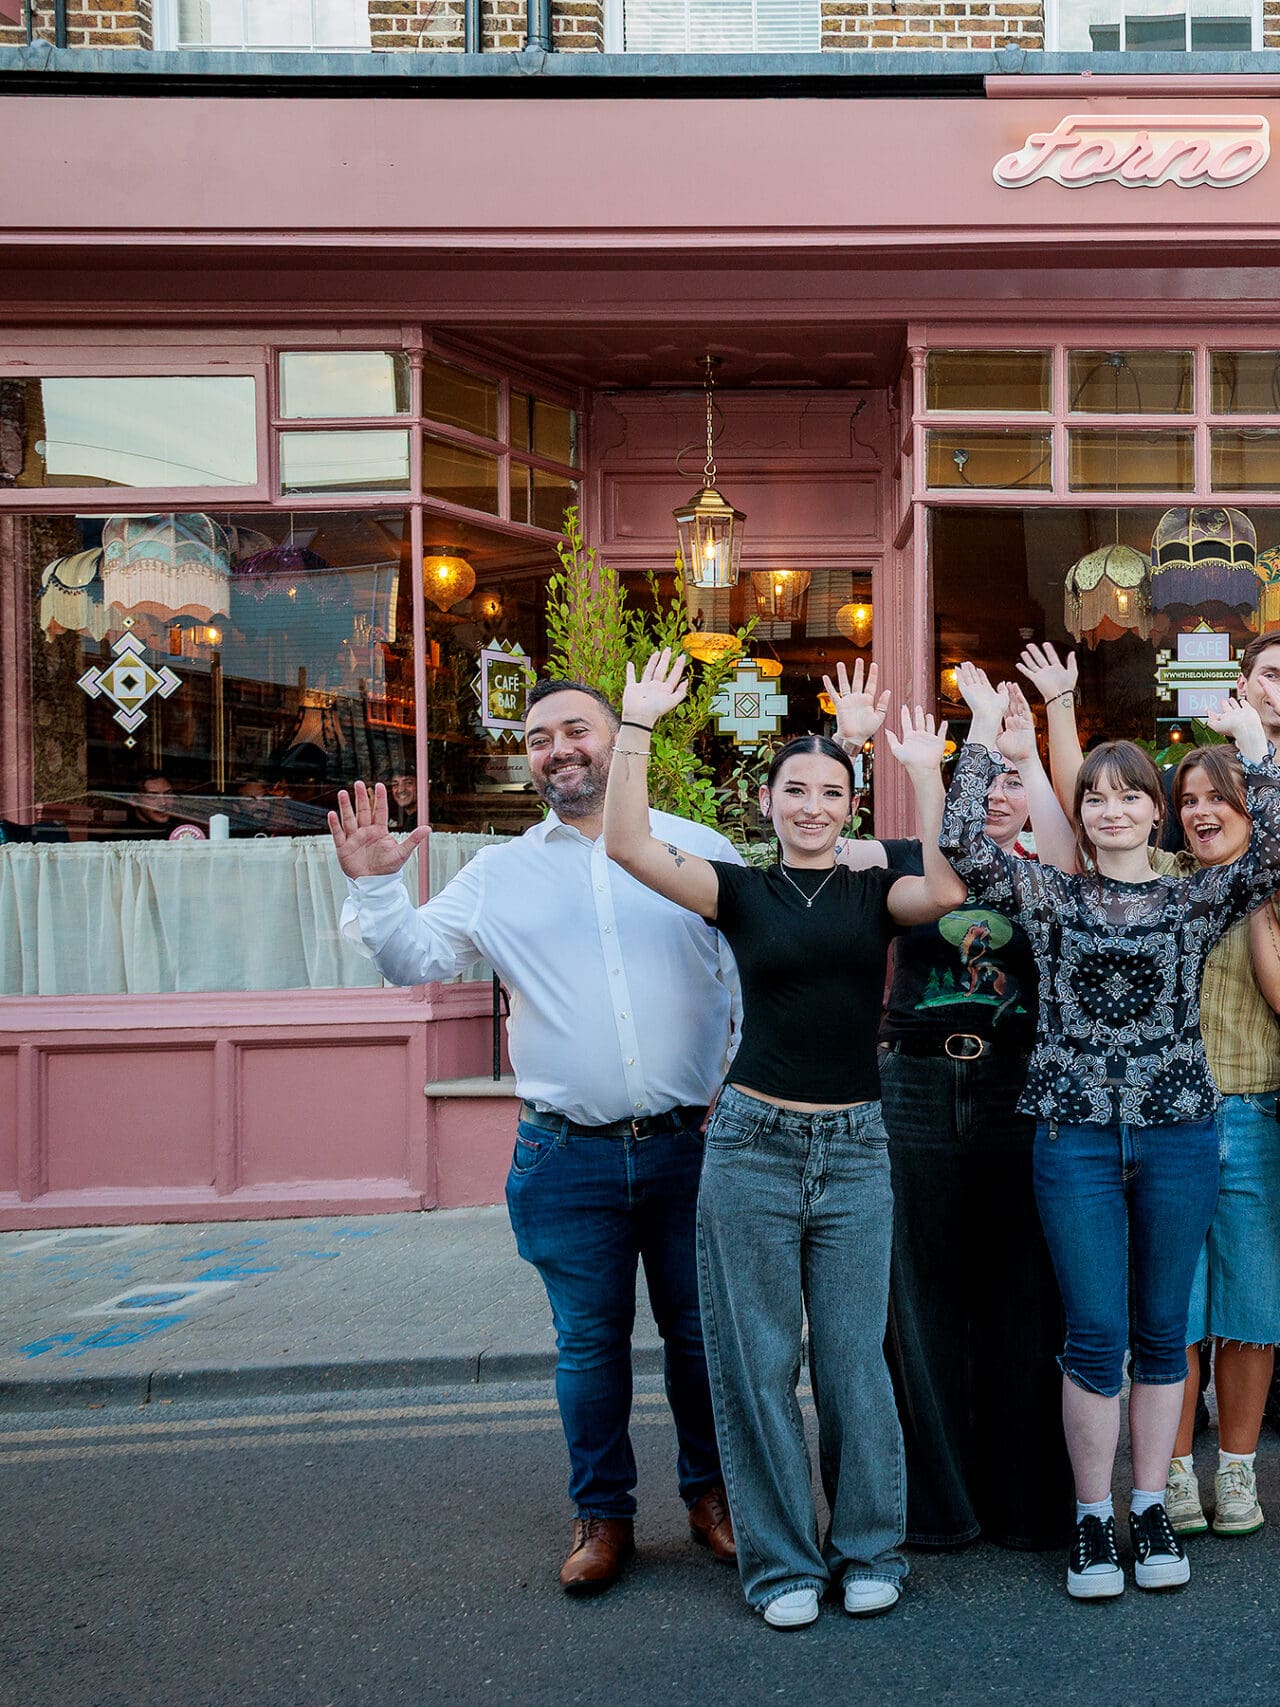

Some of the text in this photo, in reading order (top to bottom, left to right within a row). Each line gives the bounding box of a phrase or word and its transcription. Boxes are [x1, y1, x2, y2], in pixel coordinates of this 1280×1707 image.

[997, 116, 1265, 184] Forno
[1184, 637, 1224, 657] CAFÉ
[494, 673, 520, 693] CAFÉ
[497, 692, 517, 710] BAR
[1188, 694, 1218, 711] BAR
